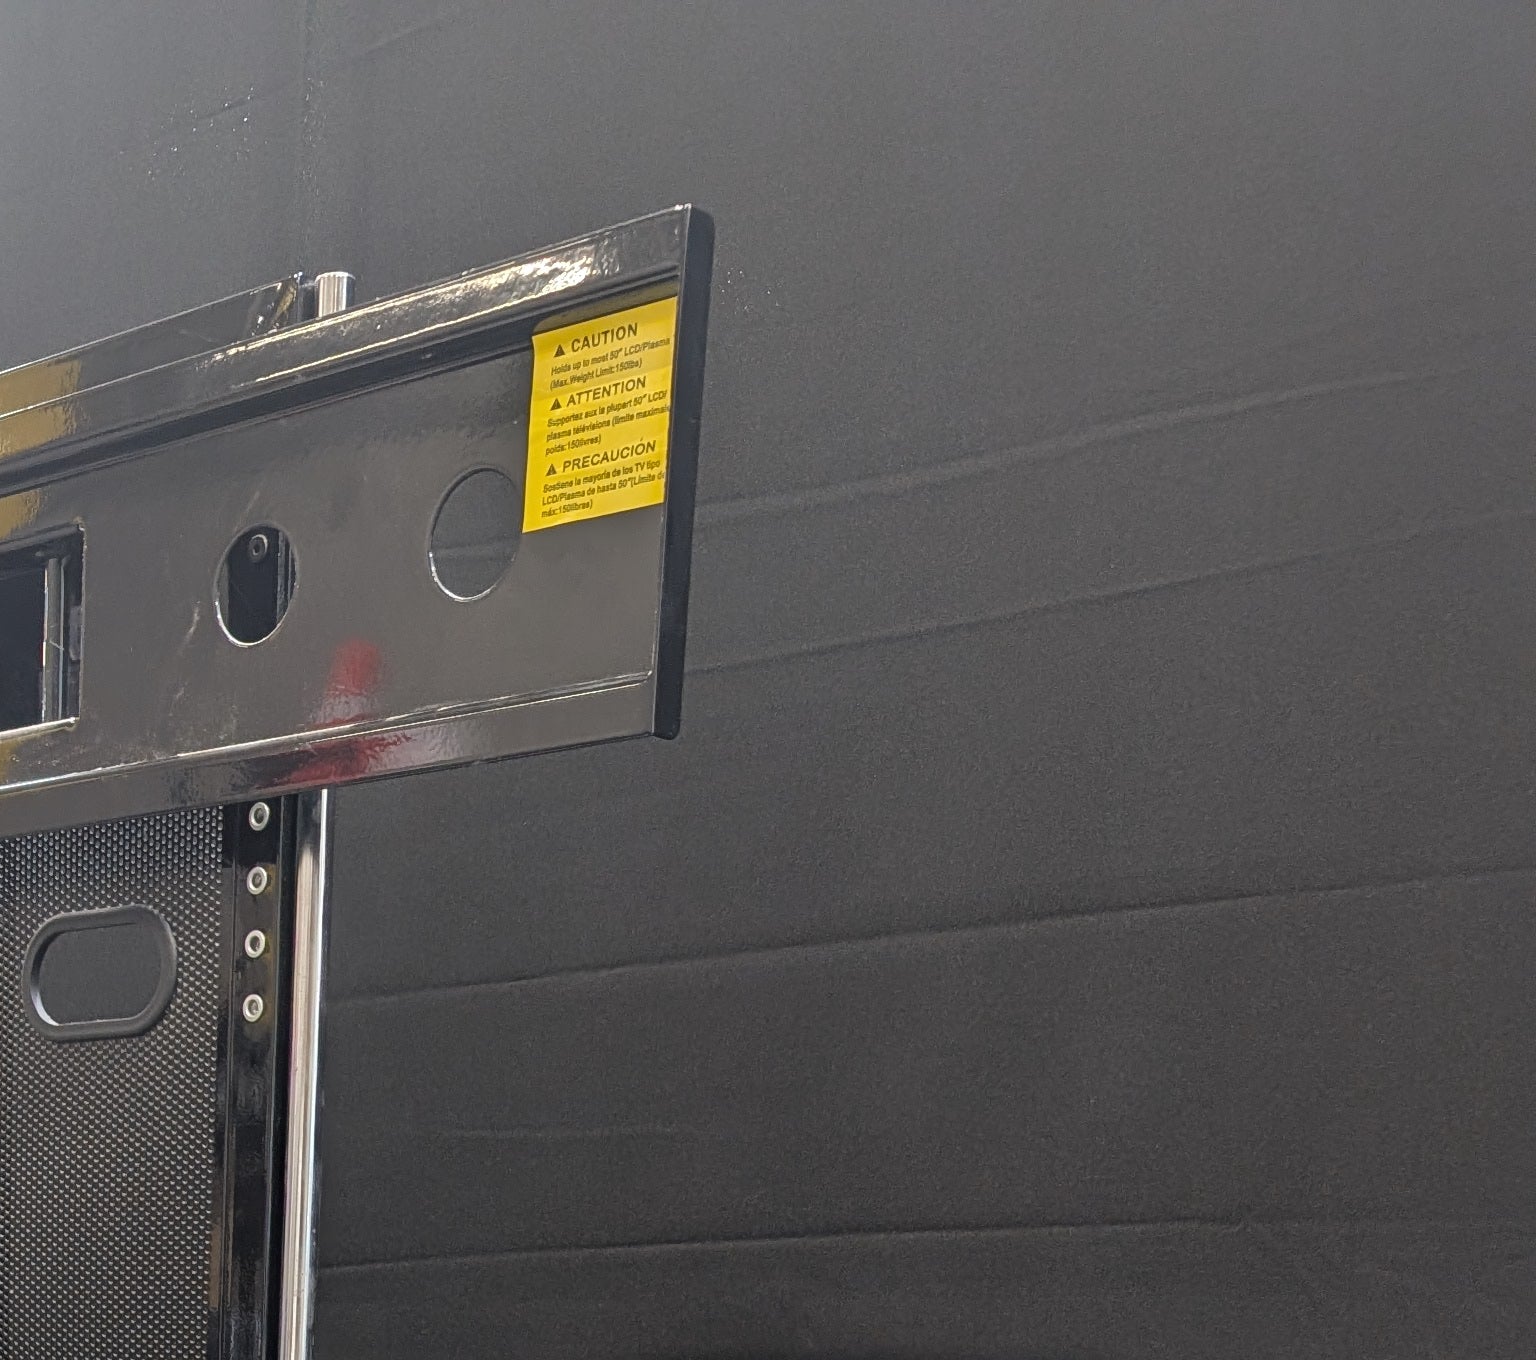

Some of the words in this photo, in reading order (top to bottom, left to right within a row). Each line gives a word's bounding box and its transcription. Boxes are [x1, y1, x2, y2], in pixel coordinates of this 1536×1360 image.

[571, 323, 638, 352] CAUTION
[551, 362, 571, 376] Holds
[572, 361, 582, 371] up
[582, 358, 590, 367] to
[590, 354, 608, 366] most
[624, 338, 670, 356] LCD/Plasma
[566, 376, 646, 407] ATTENTION
[546, 412, 583, 428] Supportez
[546, 428, 572, 442] plasma
[612, 412, 634, 427] (limite
[562, 437, 656, 472] PRECAUCIÓN
[543, 480, 573, 494] Sostiene
[612, 467, 622, 478] de
[622, 464, 634, 475] los
[634, 460, 646, 472] TV
[646, 458, 660, 470] tipo
[542, 490, 586, 506] LCD/Plasma
[586, 487, 596, 496] de
[596, 480, 616, 494] hasta
